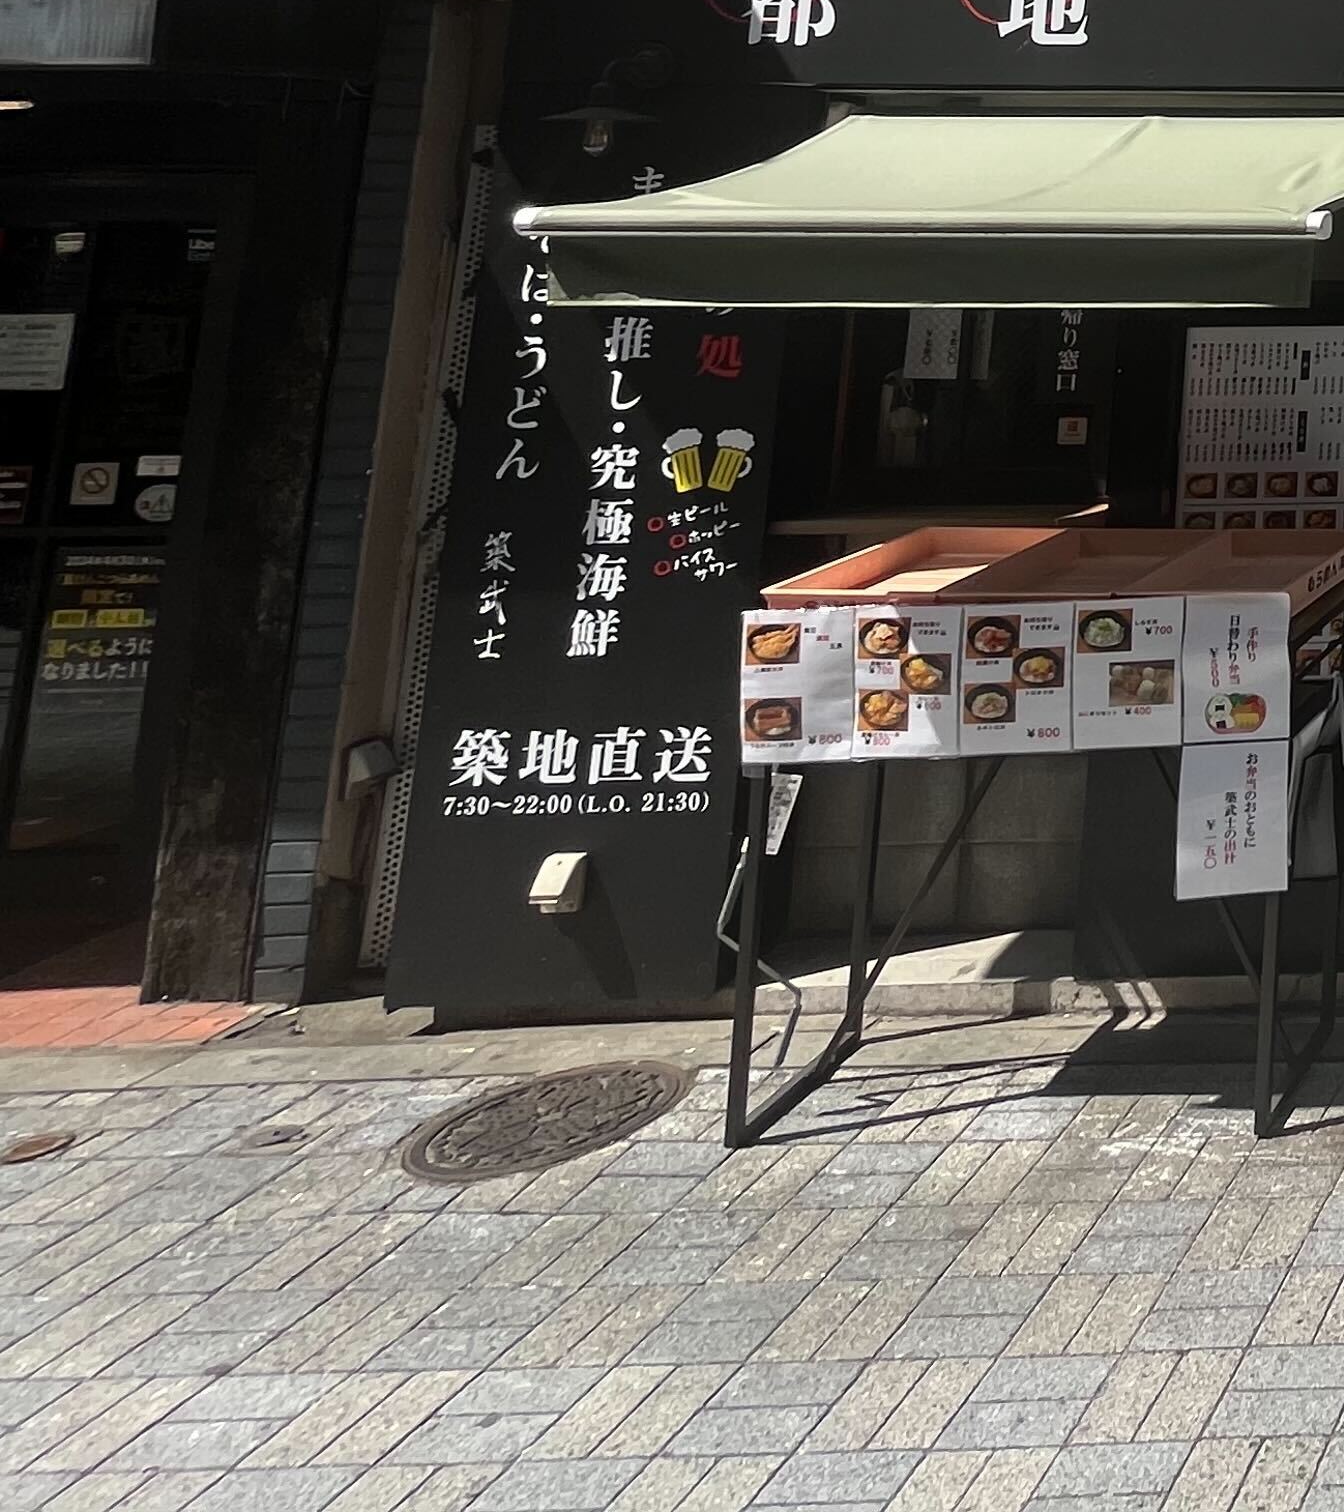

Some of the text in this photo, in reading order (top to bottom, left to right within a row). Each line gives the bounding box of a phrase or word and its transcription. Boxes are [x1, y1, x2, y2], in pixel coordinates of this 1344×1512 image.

[667, 501, 729, 527] 生ビール
[448, 725, 713, 790] 築地直送
